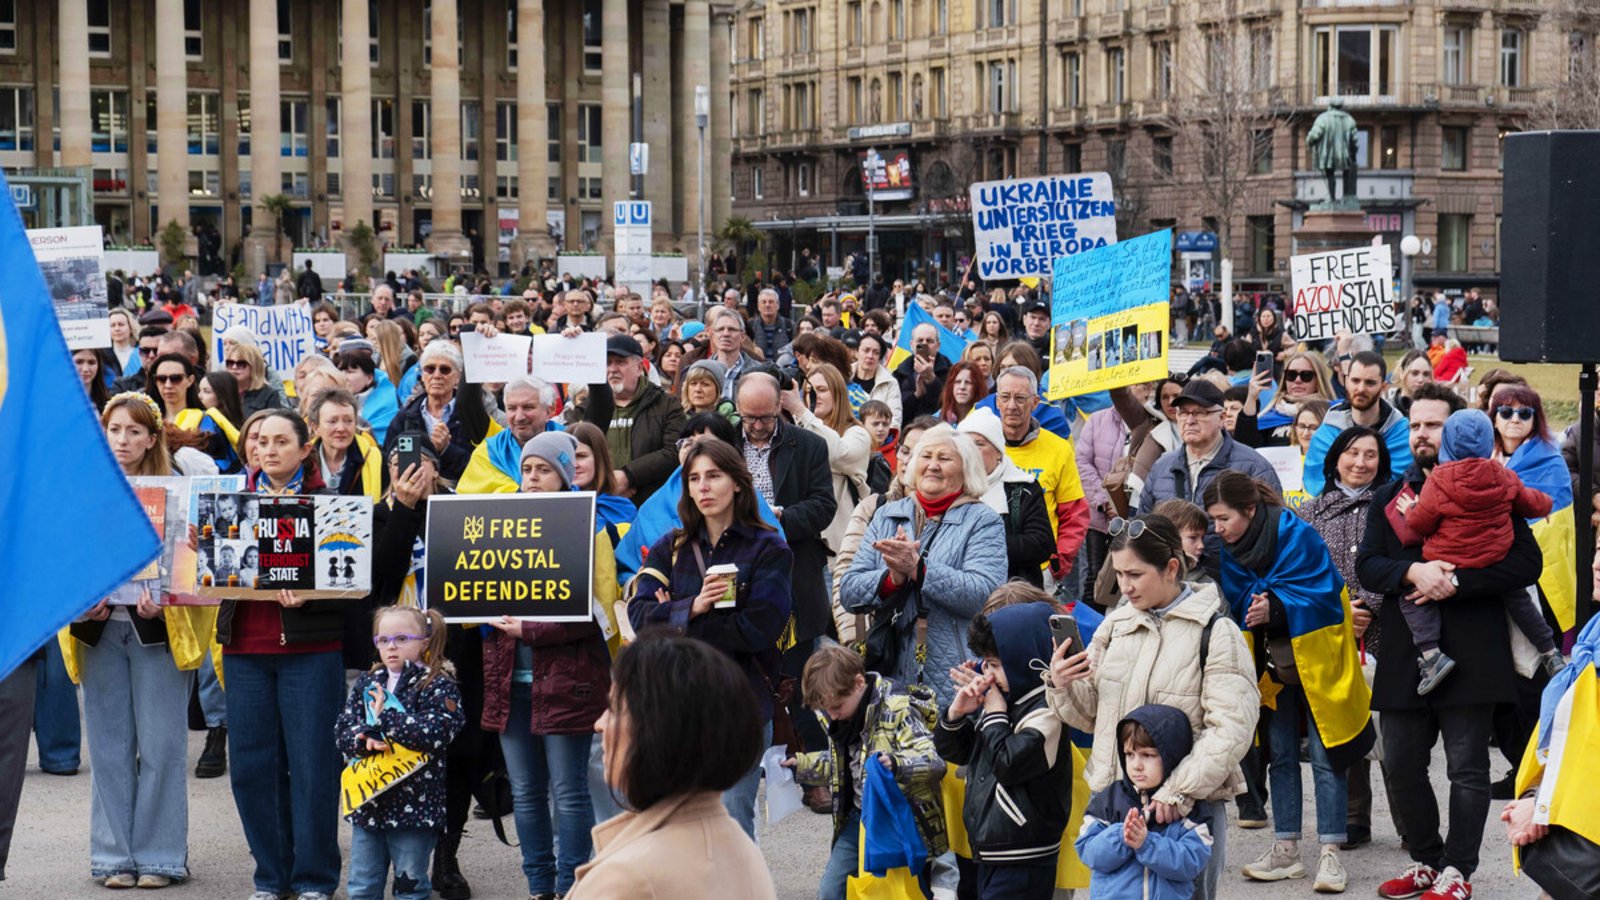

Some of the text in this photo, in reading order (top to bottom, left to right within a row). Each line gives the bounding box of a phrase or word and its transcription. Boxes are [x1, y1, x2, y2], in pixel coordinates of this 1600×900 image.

[617, 204, 625, 219] U
[633, 204, 646, 220] U
[1310, 251, 1371, 284] FREE
[1293, 278, 1393, 314] AZOVSTAL
[1295, 305, 1396, 339] DEFENDERS
[259, 517, 310, 539] RUSSIA
[490, 518, 542, 539] FREE
[273, 539, 292, 552] IS A
[259, 553, 310, 567] TERRORIST
[455, 549, 560, 570] AZOVSTAL
[269, 567, 299, 581] STATE
[444, 579, 571, 602] DEFENDERS
